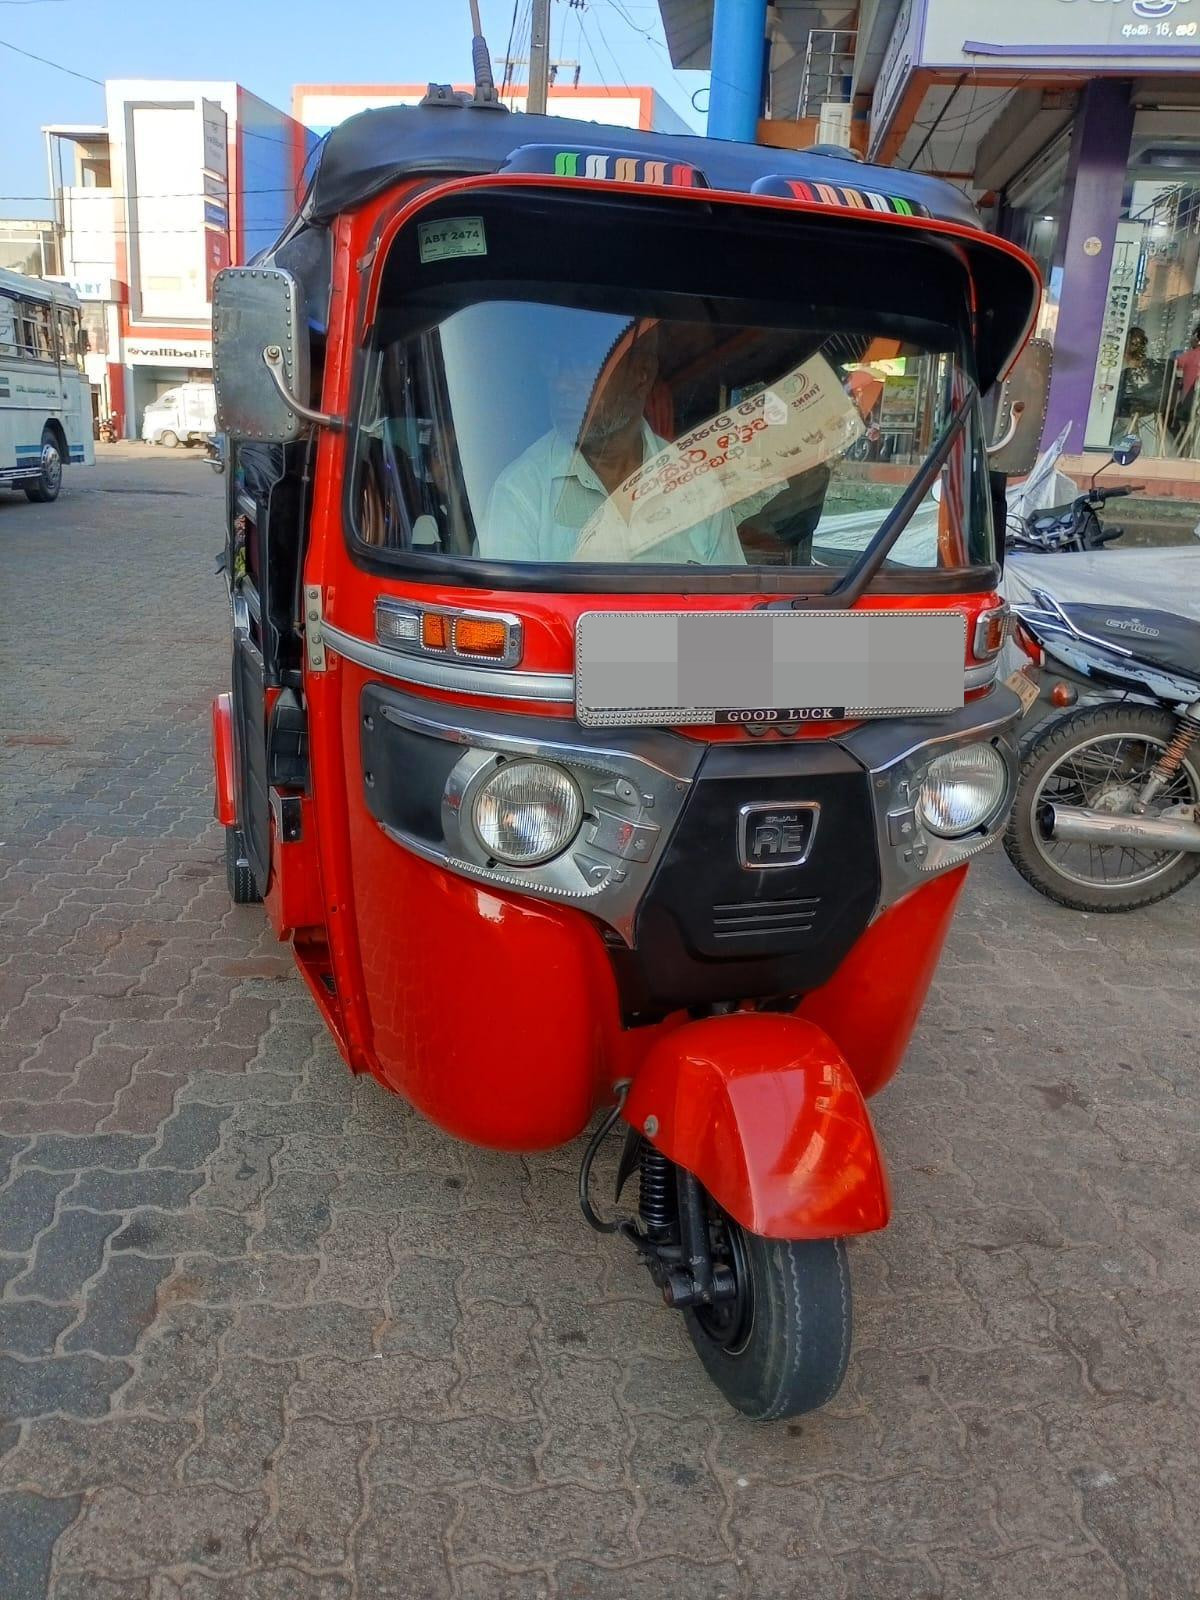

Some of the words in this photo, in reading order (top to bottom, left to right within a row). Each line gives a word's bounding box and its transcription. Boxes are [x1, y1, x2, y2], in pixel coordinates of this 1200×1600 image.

[424, 232, 448, 245] ABT
[451, 230, 480, 240] 2474
[727, 710, 778, 722] GOOD
[788, 708, 833, 720] LUCK
[753, 825, 804, 854] RE
